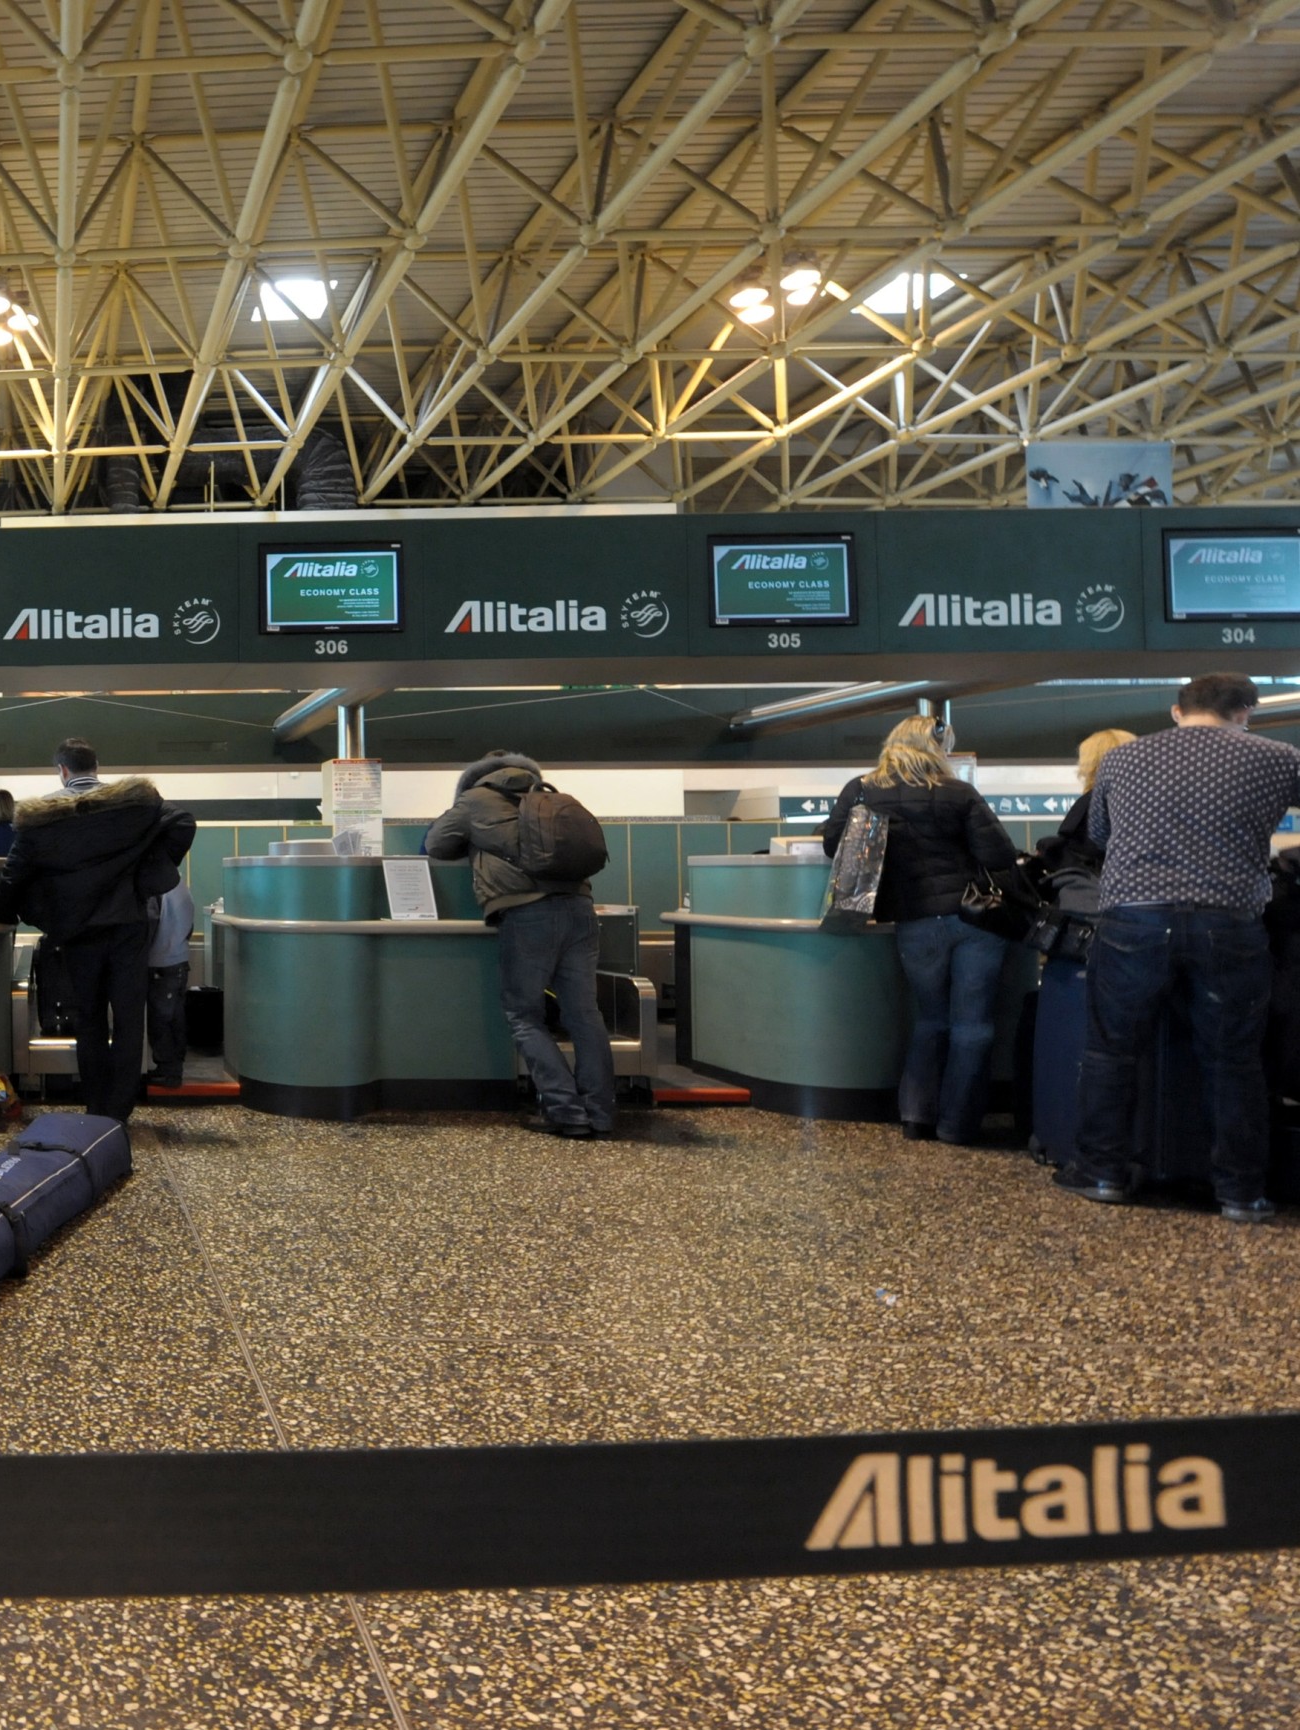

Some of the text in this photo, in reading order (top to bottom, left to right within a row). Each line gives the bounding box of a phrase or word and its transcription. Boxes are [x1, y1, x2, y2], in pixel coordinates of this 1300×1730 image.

[731, 553, 807, 570] Alitalia
[1187, 547, 1263, 565] Alitalia
[283, 561, 358, 578] Alitalia
[299, 588, 380, 597] ECONOMY CLASS
[747, 580, 830, 590] ECONOMY CLASS
[174, 598, 212, 636] SKYTEAM
[444, 600, 607, 633] Alitalia
[621, 590, 661, 629] SKYTEAM
[898, 593, 1062, 627] Alitalia
[3, 607, 160, 641] Alitalia
[767, 632, 802, 649] 305
[1221, 627, 1256, 644] 304
[314, 639, 349, 656] 306
[804, 1442, 1227, 1551] Alitalia
